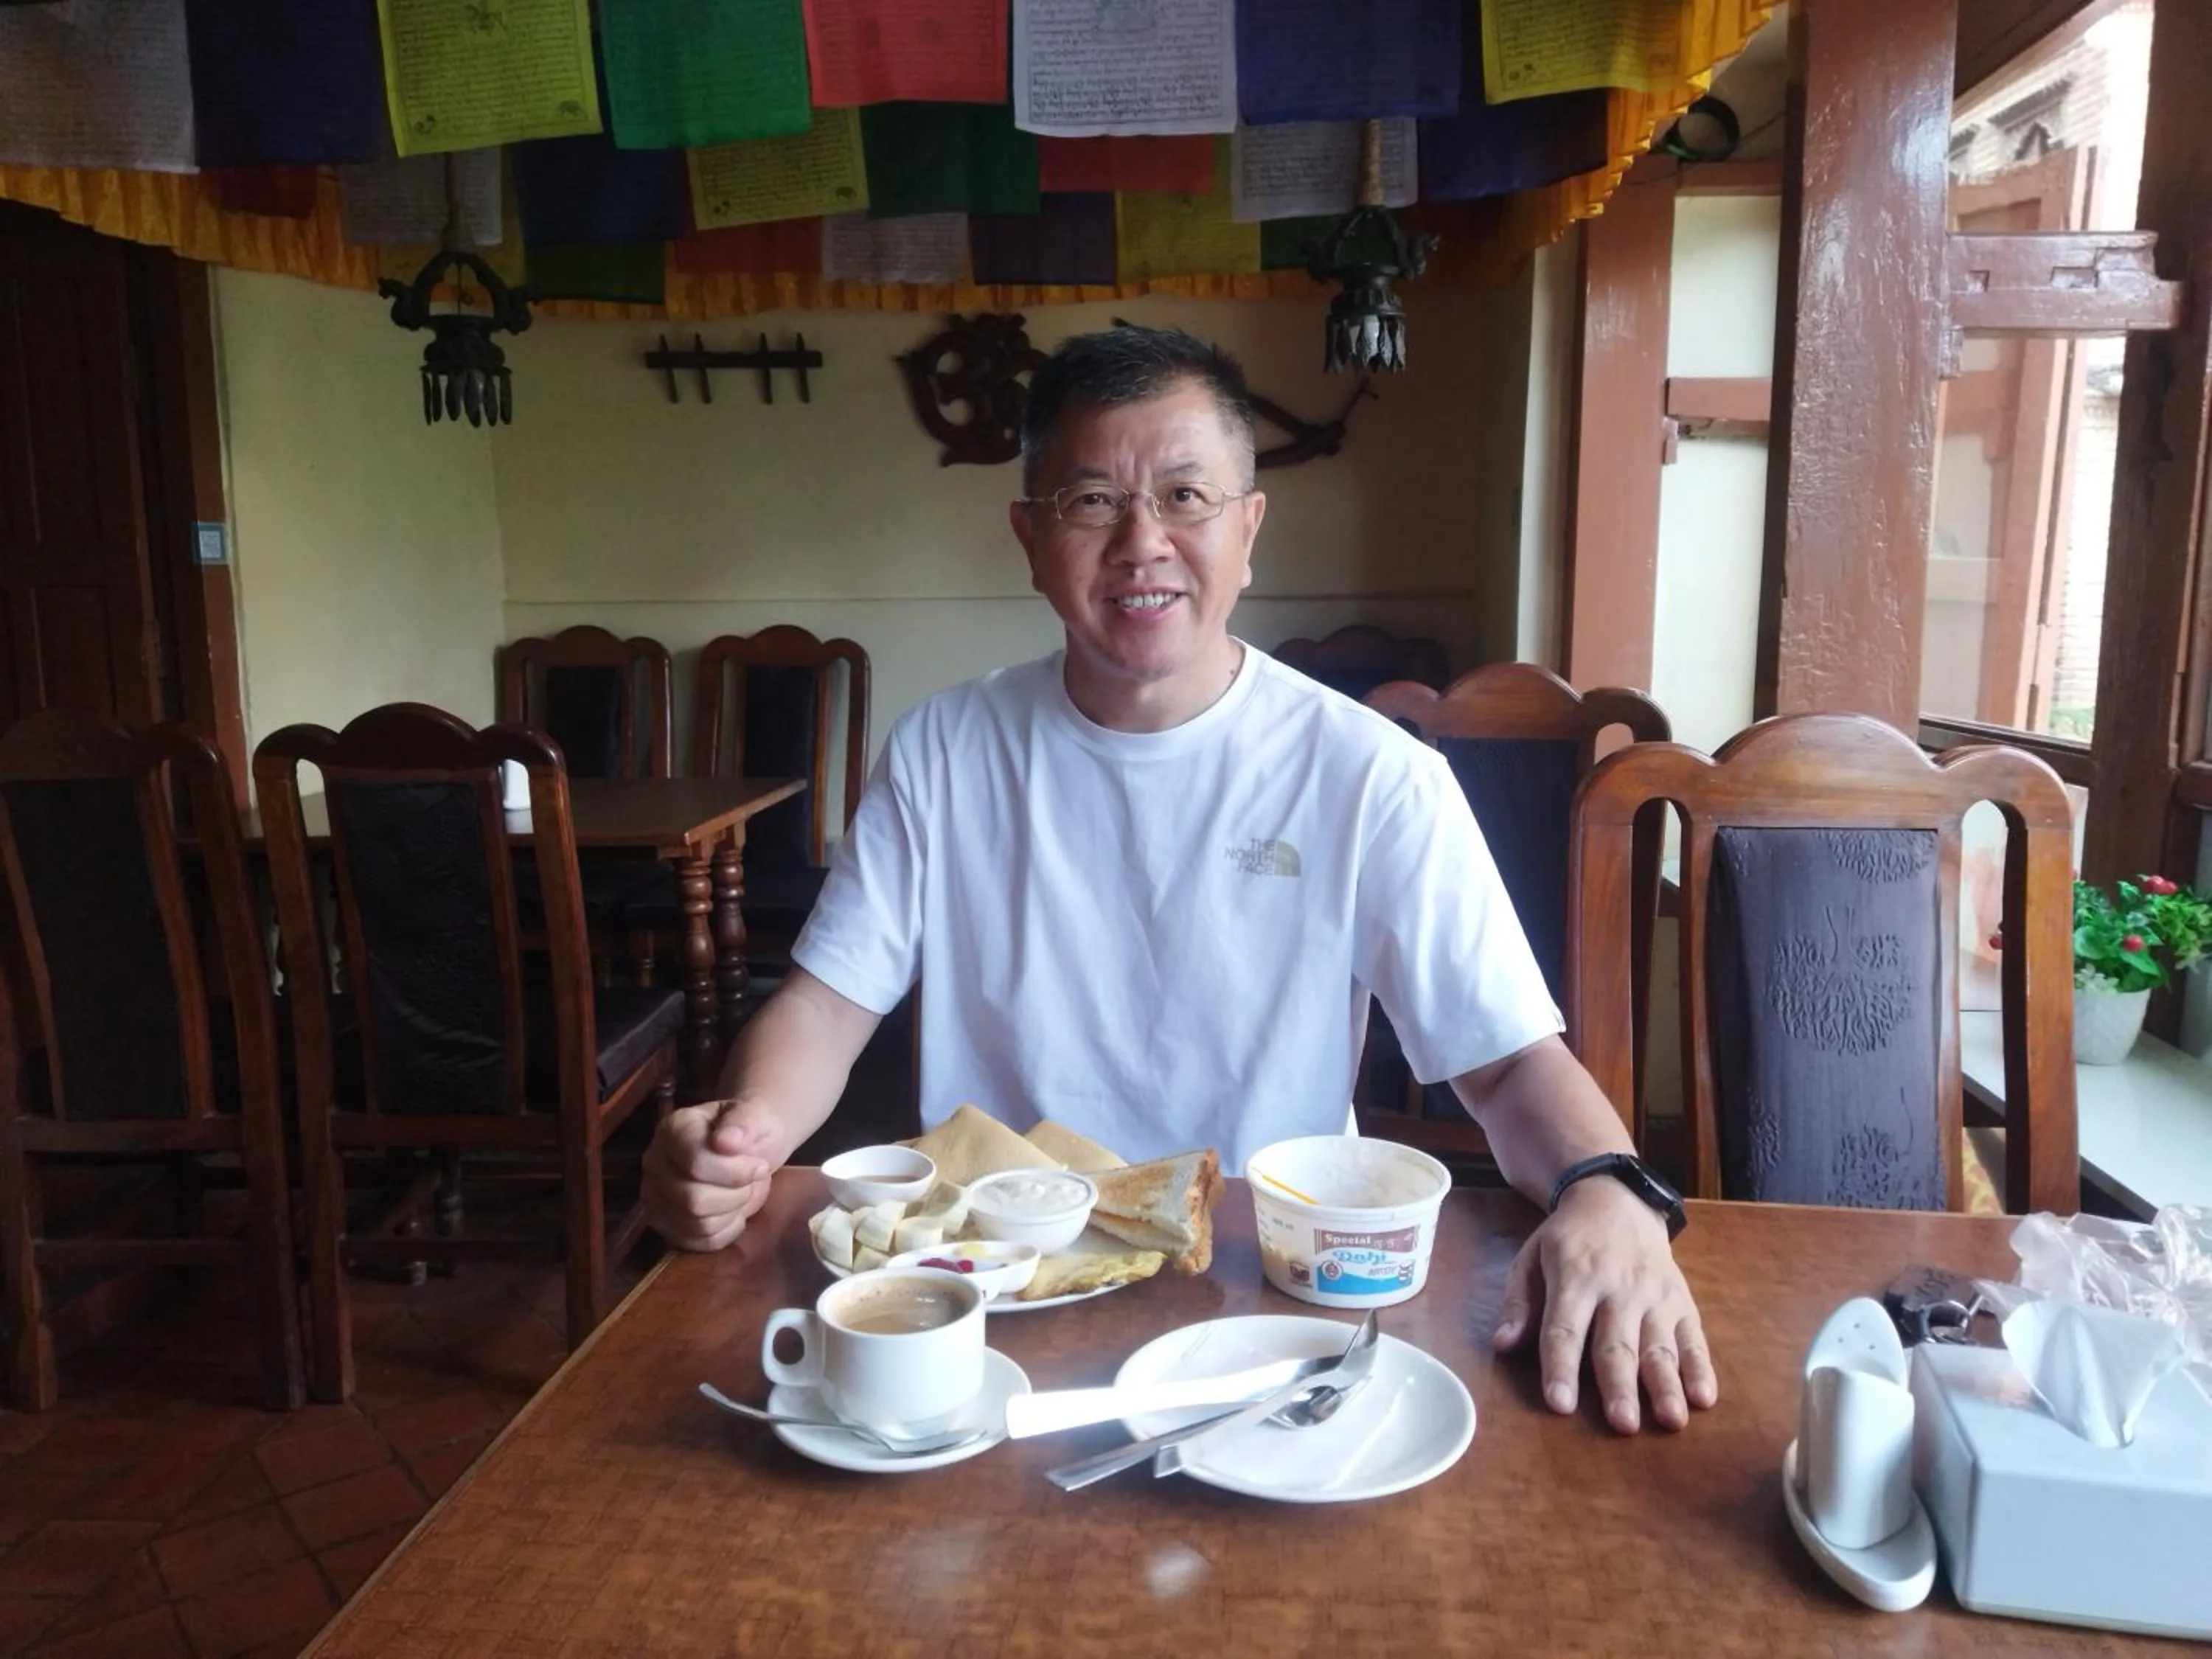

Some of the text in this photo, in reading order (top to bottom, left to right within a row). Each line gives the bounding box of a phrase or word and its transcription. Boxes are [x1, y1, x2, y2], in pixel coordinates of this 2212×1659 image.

[1251, 838, 1275, 852] THE
[1238, 861, 1274, 875] FACE
[1325, 1234, 1371, 1245] Special
[1332, 1251, 1386, 1266] Dahi
